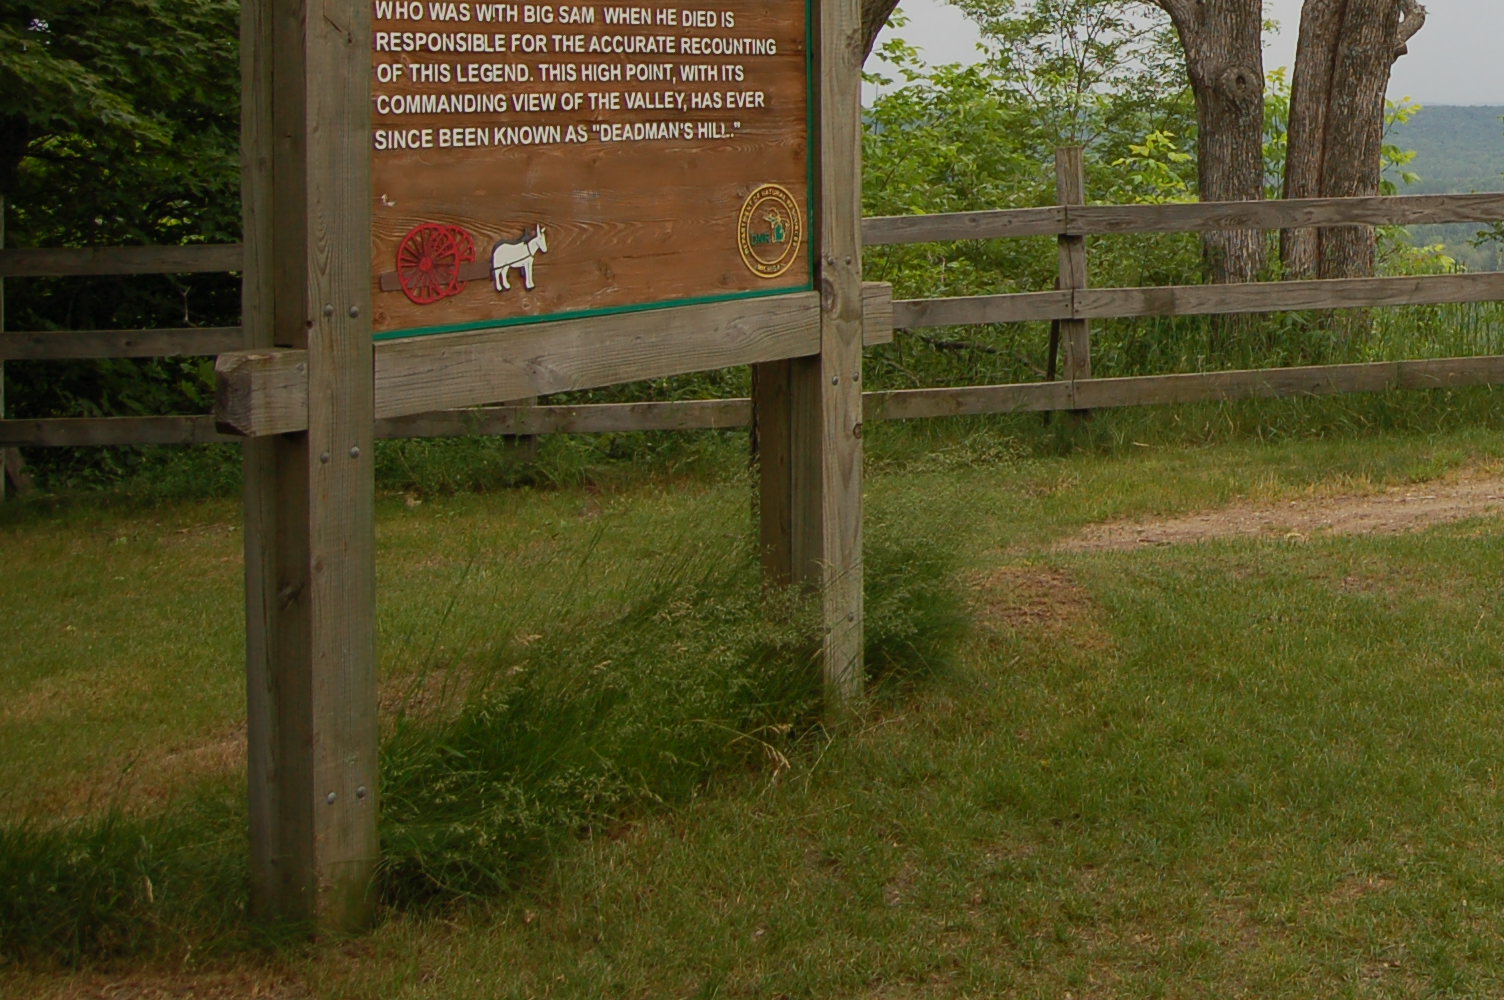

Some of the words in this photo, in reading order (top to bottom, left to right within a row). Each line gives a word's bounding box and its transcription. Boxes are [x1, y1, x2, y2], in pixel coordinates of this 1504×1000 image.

[375, 0, 423, 20] WHO
[428, 2, 470, 22] WAS
[475, 4, 518, 22] WITH
[524, 5, 554, 23] BIG
[558, 5, 595, 24] SAM
[603, 7, 651, 25] WHEN
[656, 8, 677, 25] HE
[682, 10, 717, 27] DIED
[721, 11, 735, 28] IS
[376, 32, 506, 52] RESPONSIBLE
[511, 33, 547, 52] FOR
[551, 34, 585, 53] THE
[588, 35, 676, 53] ACCURATE
[680, 37, 776, 55] RECOUNTING
[377, 63, 403, 83] OF
[408, 63, 451, 83] THIS
[456, 63, 534, 82] LEGEND.
[538, 63, 577, 82] THIS
[581, 63, 621, 82] HIGH
[626, 63, 676, 84] POINT,
[680, 65, 718, 82] WITH
[721, 65, 744, 82] ITS
[377, 93, 507, 114] COMMANDING
[512, 93, 557, 111] VIEW
[560, 92, 584, 111] OF
[587, 92, 620, 110] THE
[624, 91, 687, 112] VALLEY,
[691, 91, 722, 109] HAS
[726, 91, 765, 108] EVER
[374, 129, 433, 150] SINCE
[439, 127, 489, 147] BEEN
[494, 125, 561, 146] KNOWN
[564, 125, 588, 143] AS
[592, 122, 694, 142] "DEADMAN'S
